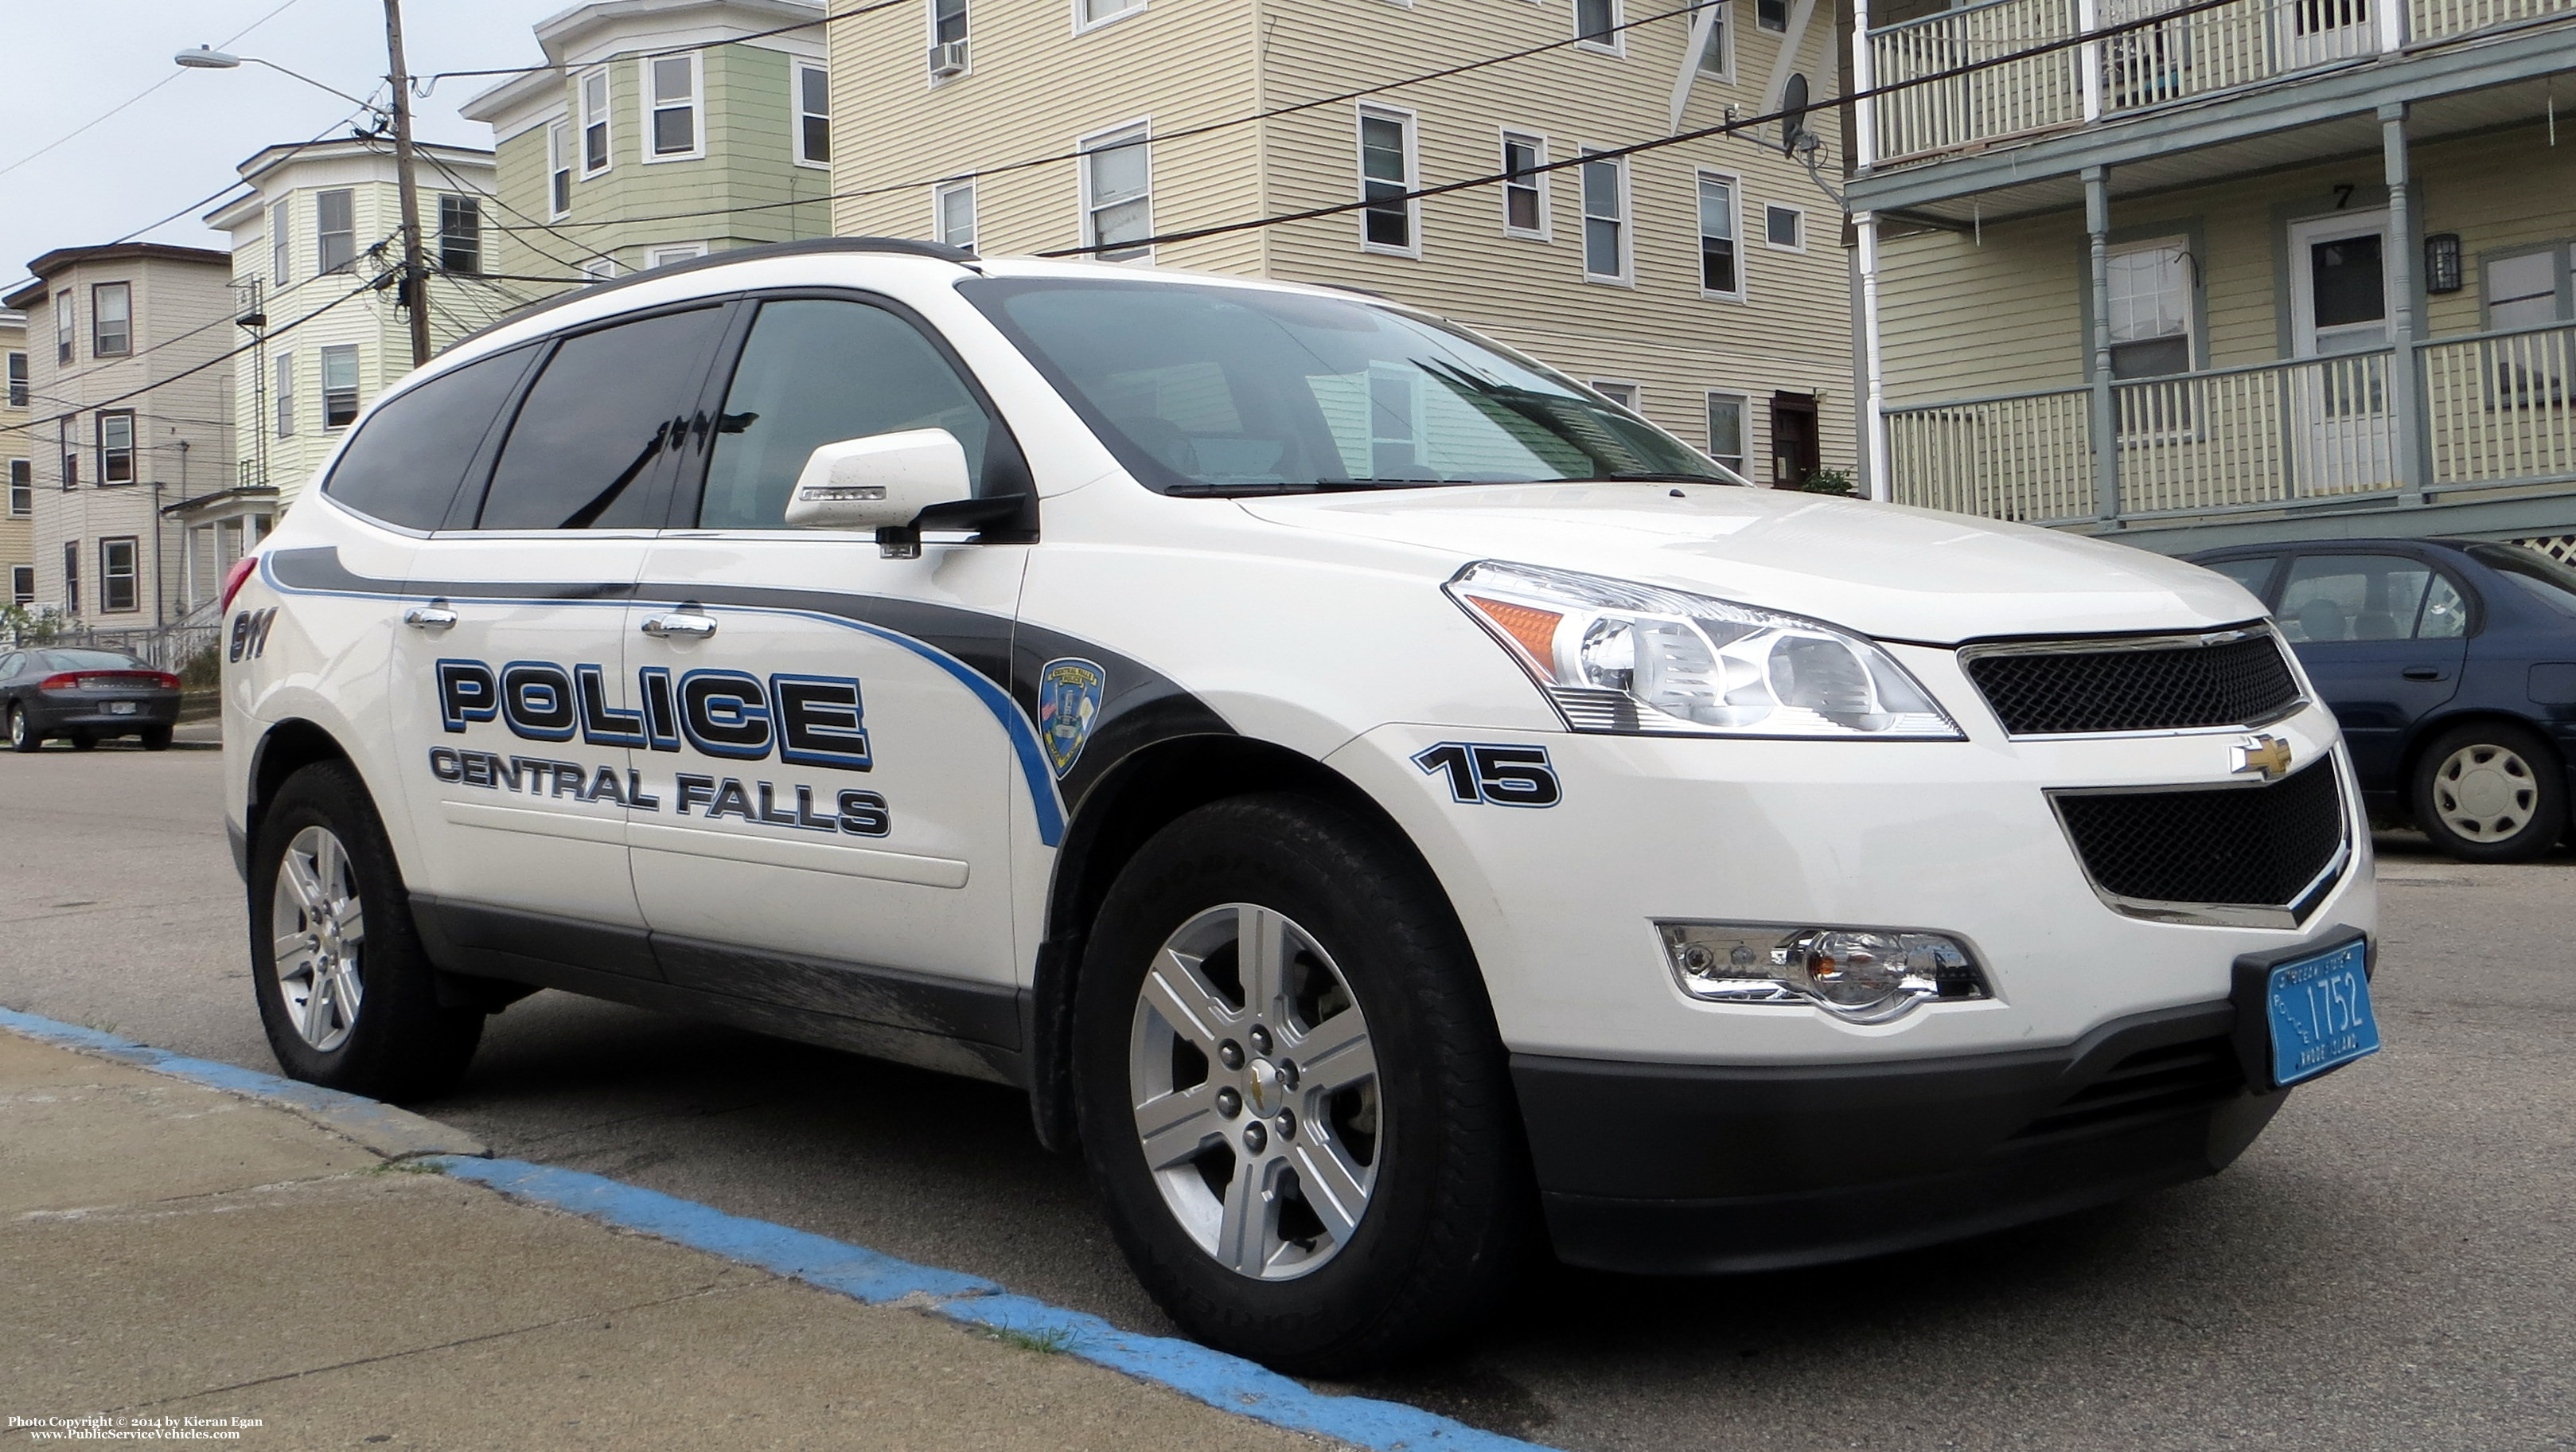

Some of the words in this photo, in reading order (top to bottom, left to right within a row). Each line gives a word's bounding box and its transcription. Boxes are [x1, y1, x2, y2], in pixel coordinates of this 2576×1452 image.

[2333, 184, 2354, 209] 7
[230, 606, 279, 663] 911
[436, 658, 873, 772] POLICE
[429, 746, 660, 812] CENTRAL
[675, 772, 891, 838] FALLS
[1409, 741, 1562, 808] 15
[2274, 994, 2309, 1044] POLICE
[2307, 972, 2363, 1040] 1752
[2301, 1044, 2325, 1068] RHODE
[2329, 1033, 2356, 1056] ISLAND
